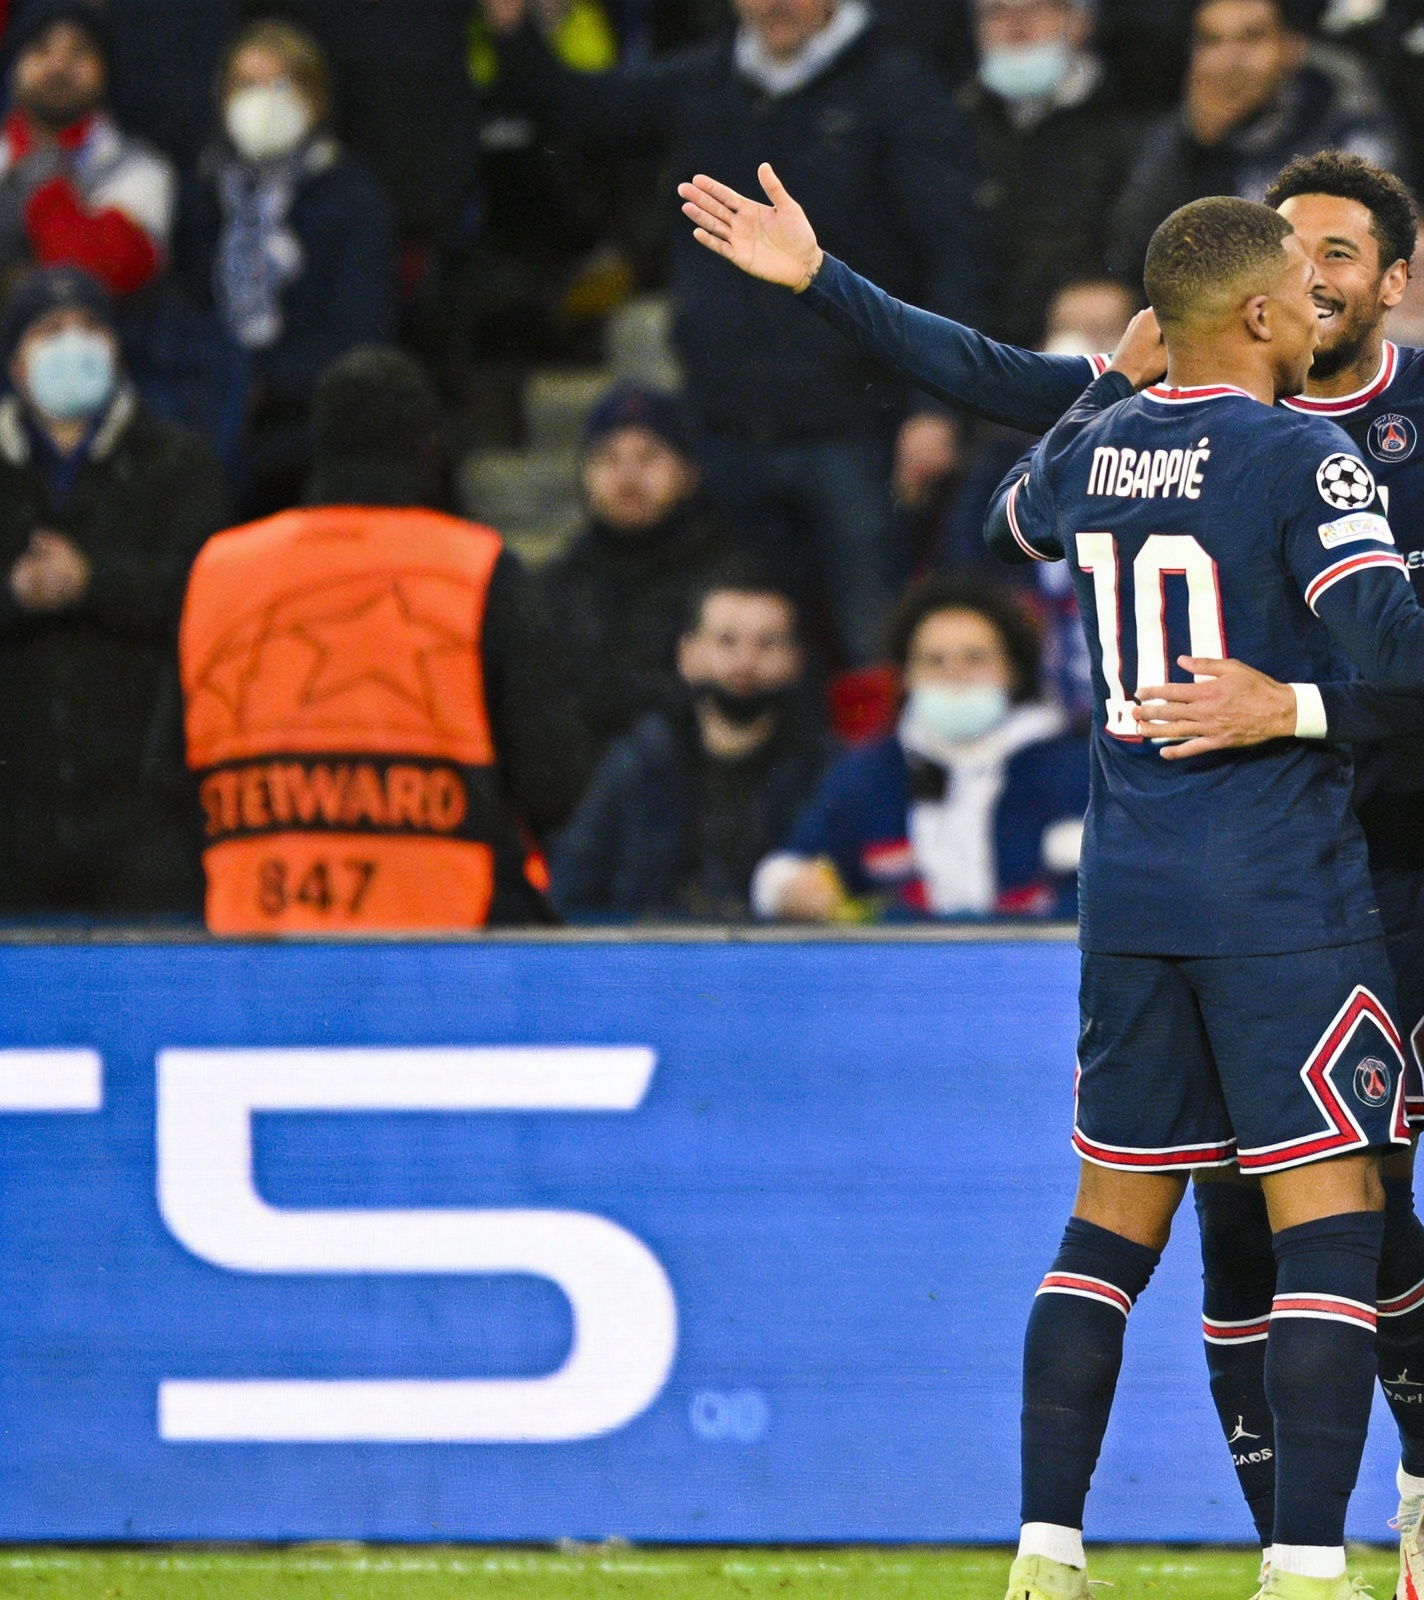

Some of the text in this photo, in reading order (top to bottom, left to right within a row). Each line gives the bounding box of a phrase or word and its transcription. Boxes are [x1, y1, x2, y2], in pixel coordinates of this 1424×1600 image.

[1075, 532, 1229, 742] 10
[256, 857, 377, 918] 847
[0, 1047, 677, 1443] 5
